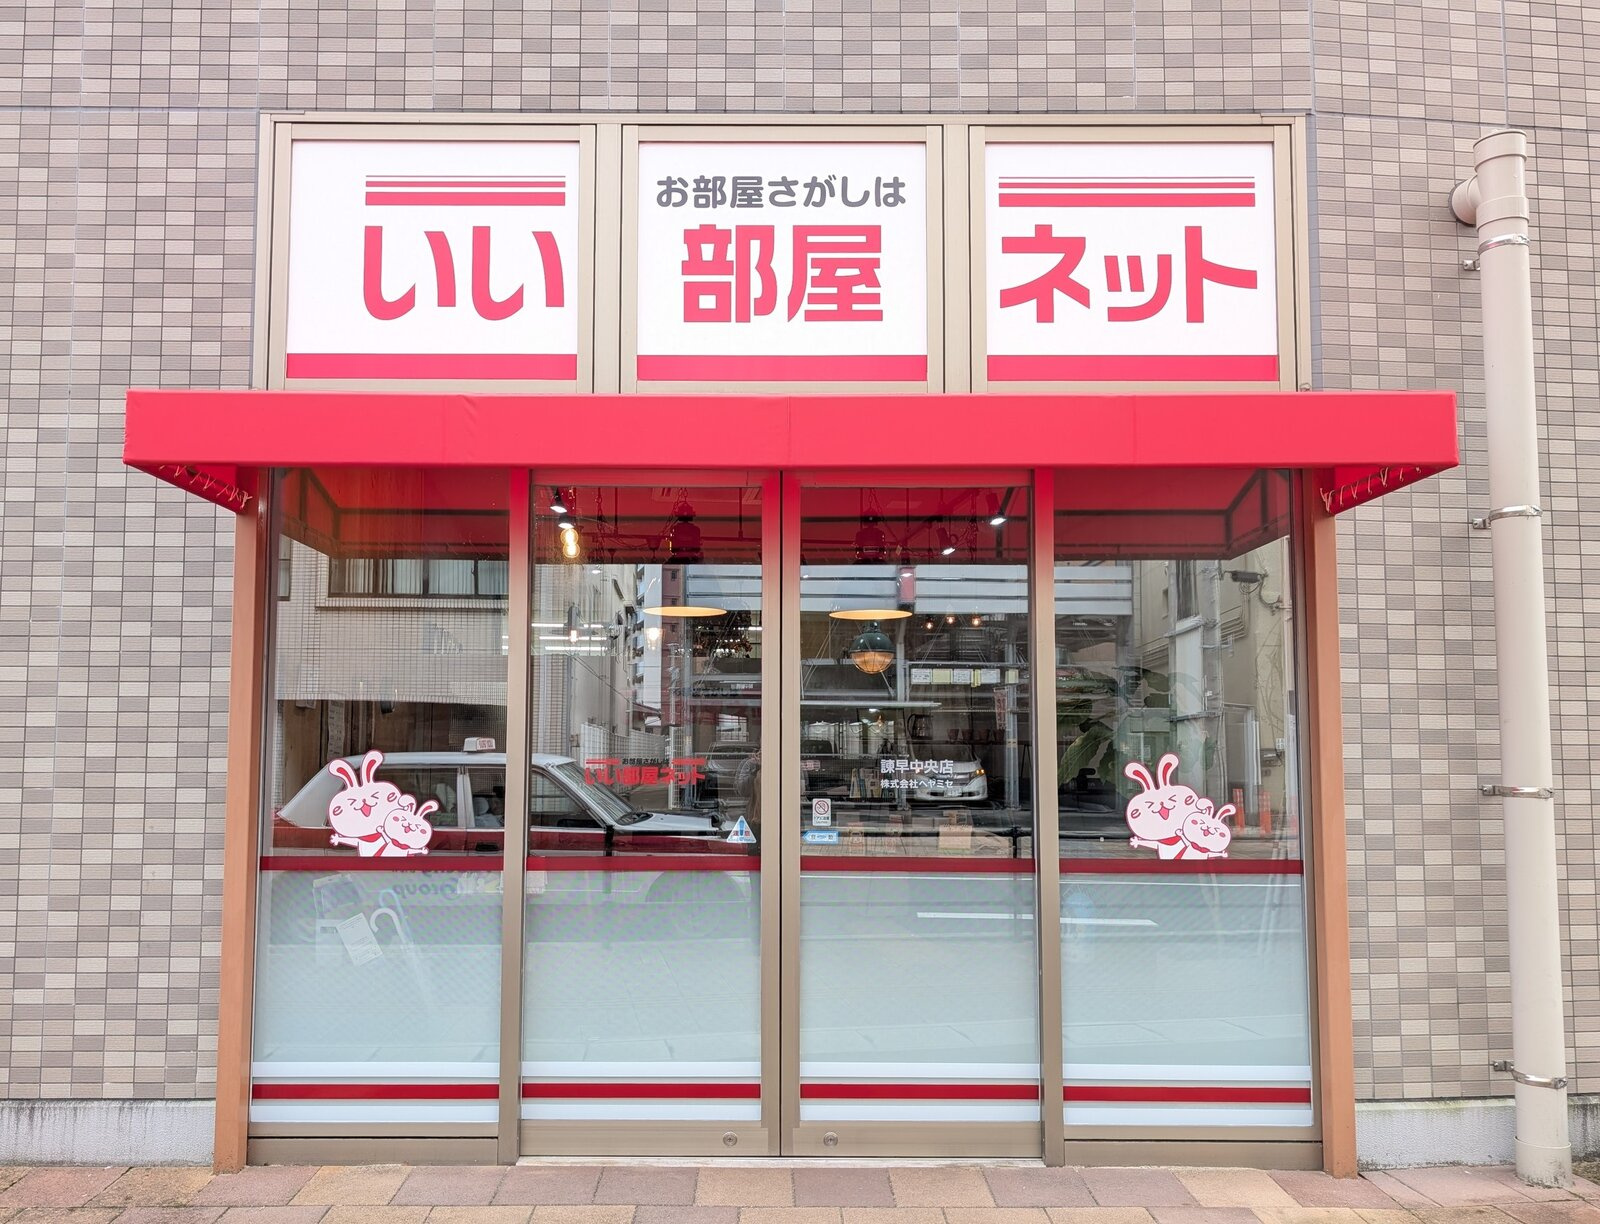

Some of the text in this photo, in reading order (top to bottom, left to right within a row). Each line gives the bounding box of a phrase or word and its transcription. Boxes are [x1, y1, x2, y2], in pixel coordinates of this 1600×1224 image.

[656, 175, 906, 209] お部屋さがしは
[363, 224, 1258, 324] いい 部屋 ネット
[584, 766, 706, 786] いい部屋ネット
[880, 759, 954, 774] 諫早中央店
[880, 779, 954, 789] 株式会社ヘヤミセ
